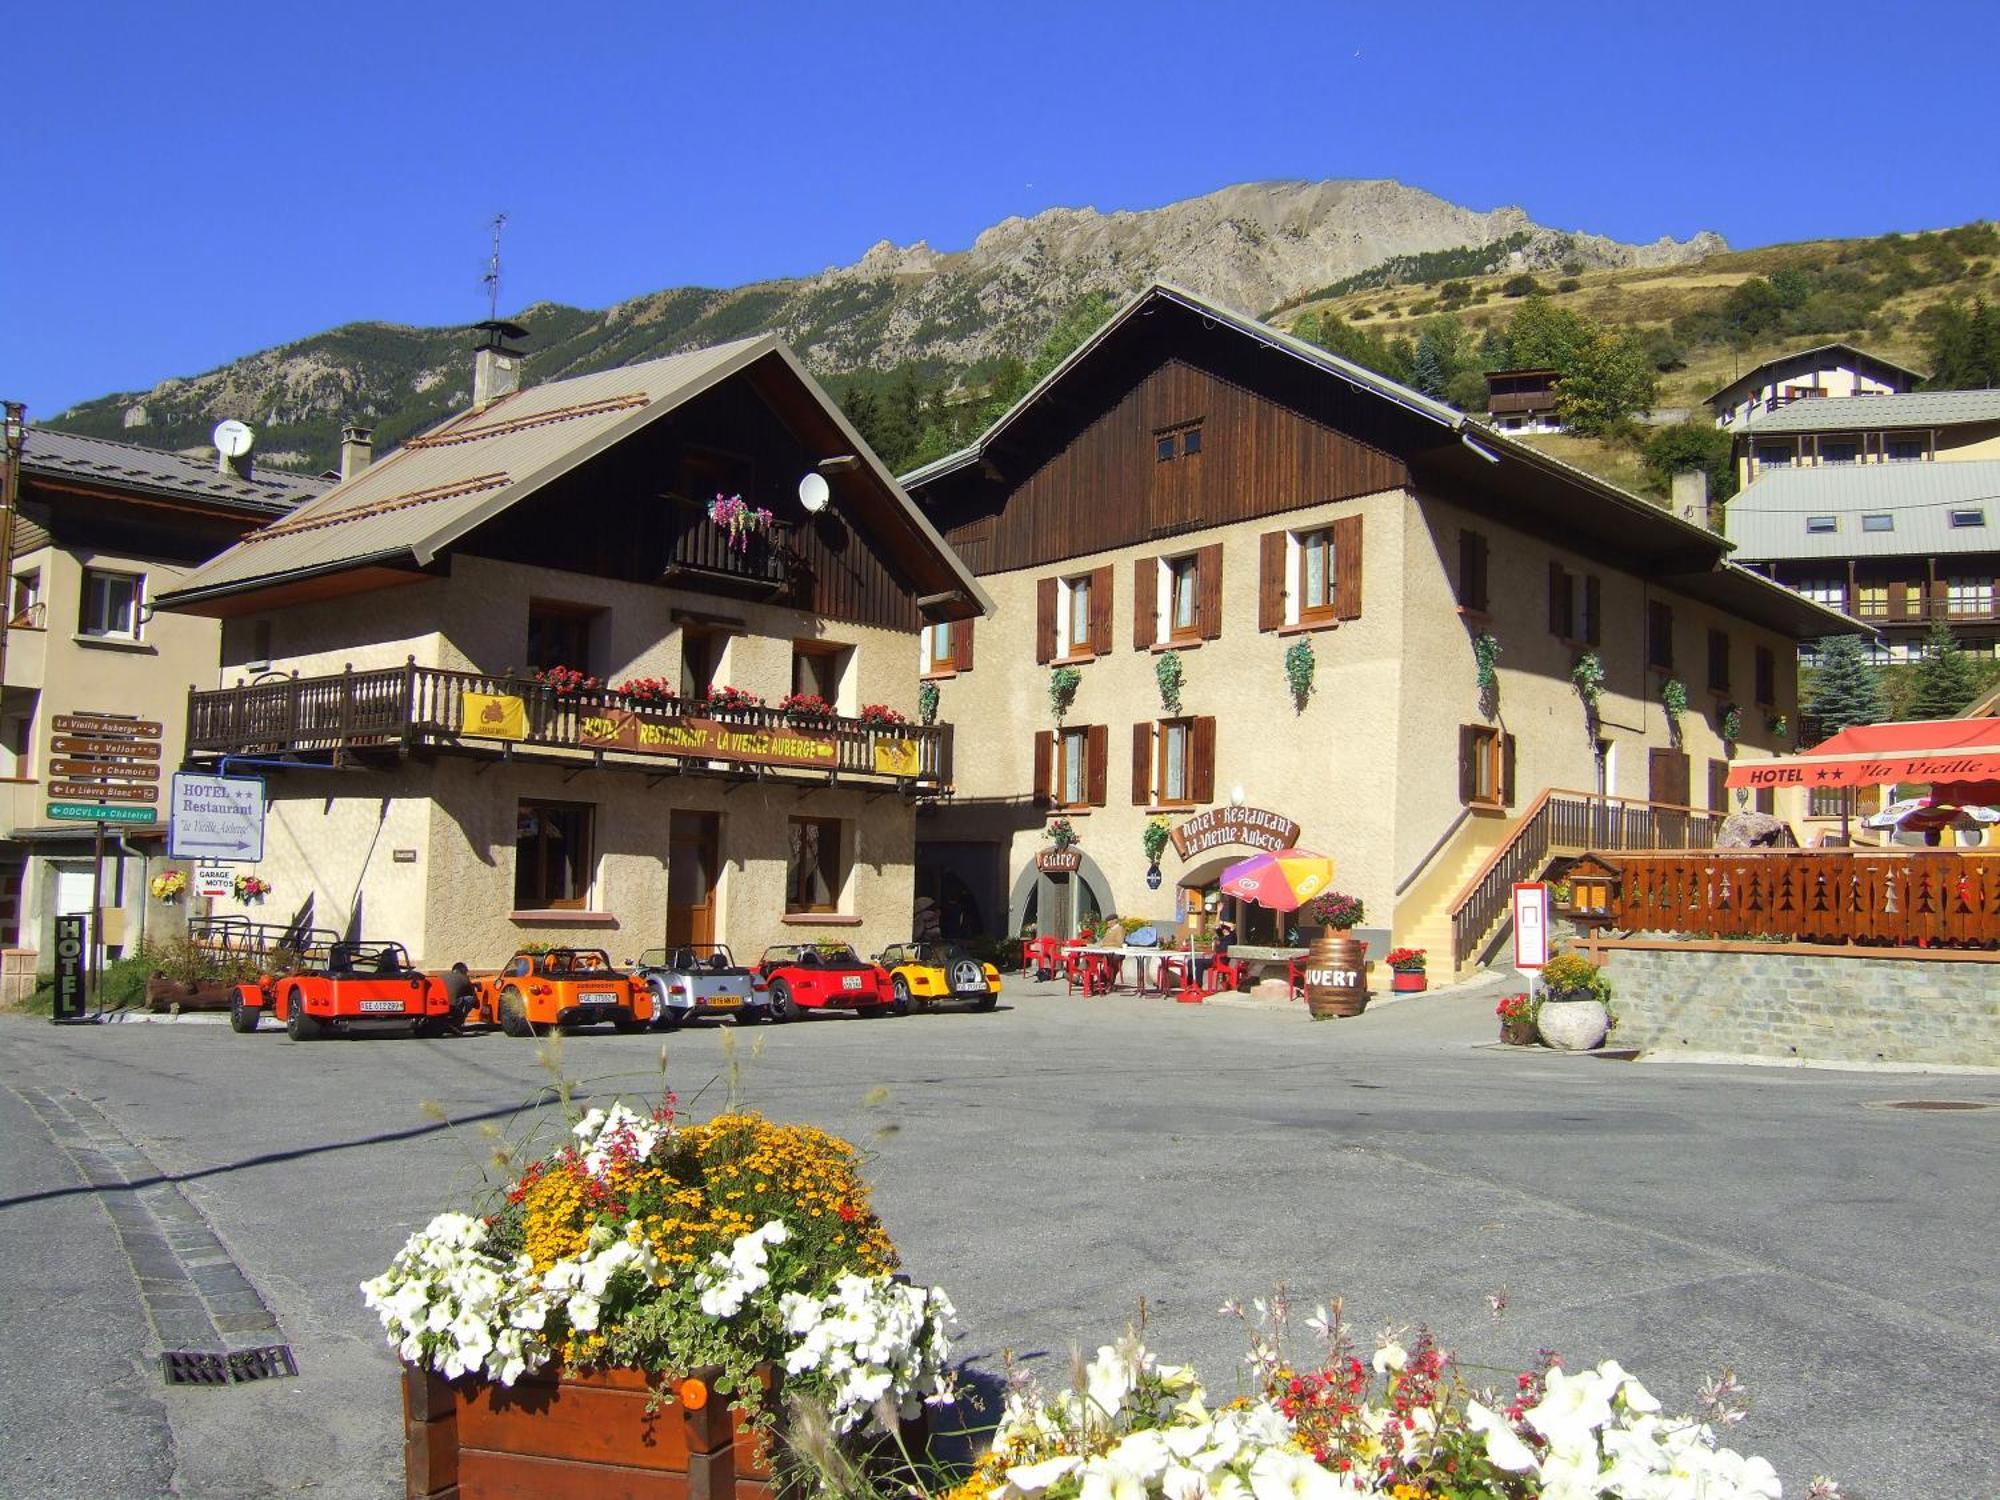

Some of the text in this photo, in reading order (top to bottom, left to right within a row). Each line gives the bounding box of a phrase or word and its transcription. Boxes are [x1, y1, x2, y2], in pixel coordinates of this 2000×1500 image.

[71, 719, 99, 730] Vieille
[102, 723, 137, 733] Auberge
[581, 716, 619, 741] HOTEL
[640, 723, 708, 748] RESTAURANT
[716, 732, 729, 751] LA
[731, 733, 770, 755] VIEILLE
[771, 737, 817, 759] AUBERGE
[88, 743, 99, 752] Le
[92, 766, 147, 777] Le Chamois
[1750, 768, 1804, 784] HOTEL
[1905, 759, 1984, 776] Vieille
[65, 783, 76, 792] Le
[184, 784, 230, 799] HOTEL
[183, 800, 252, 816] Restaurant
[199, 871, 230, 879] GARAGE
[205, 879, 234, 888] MOTOS
[58, 920, 82, 1013] HOTEL
[1305, 969, 1358, 988] UVERT
